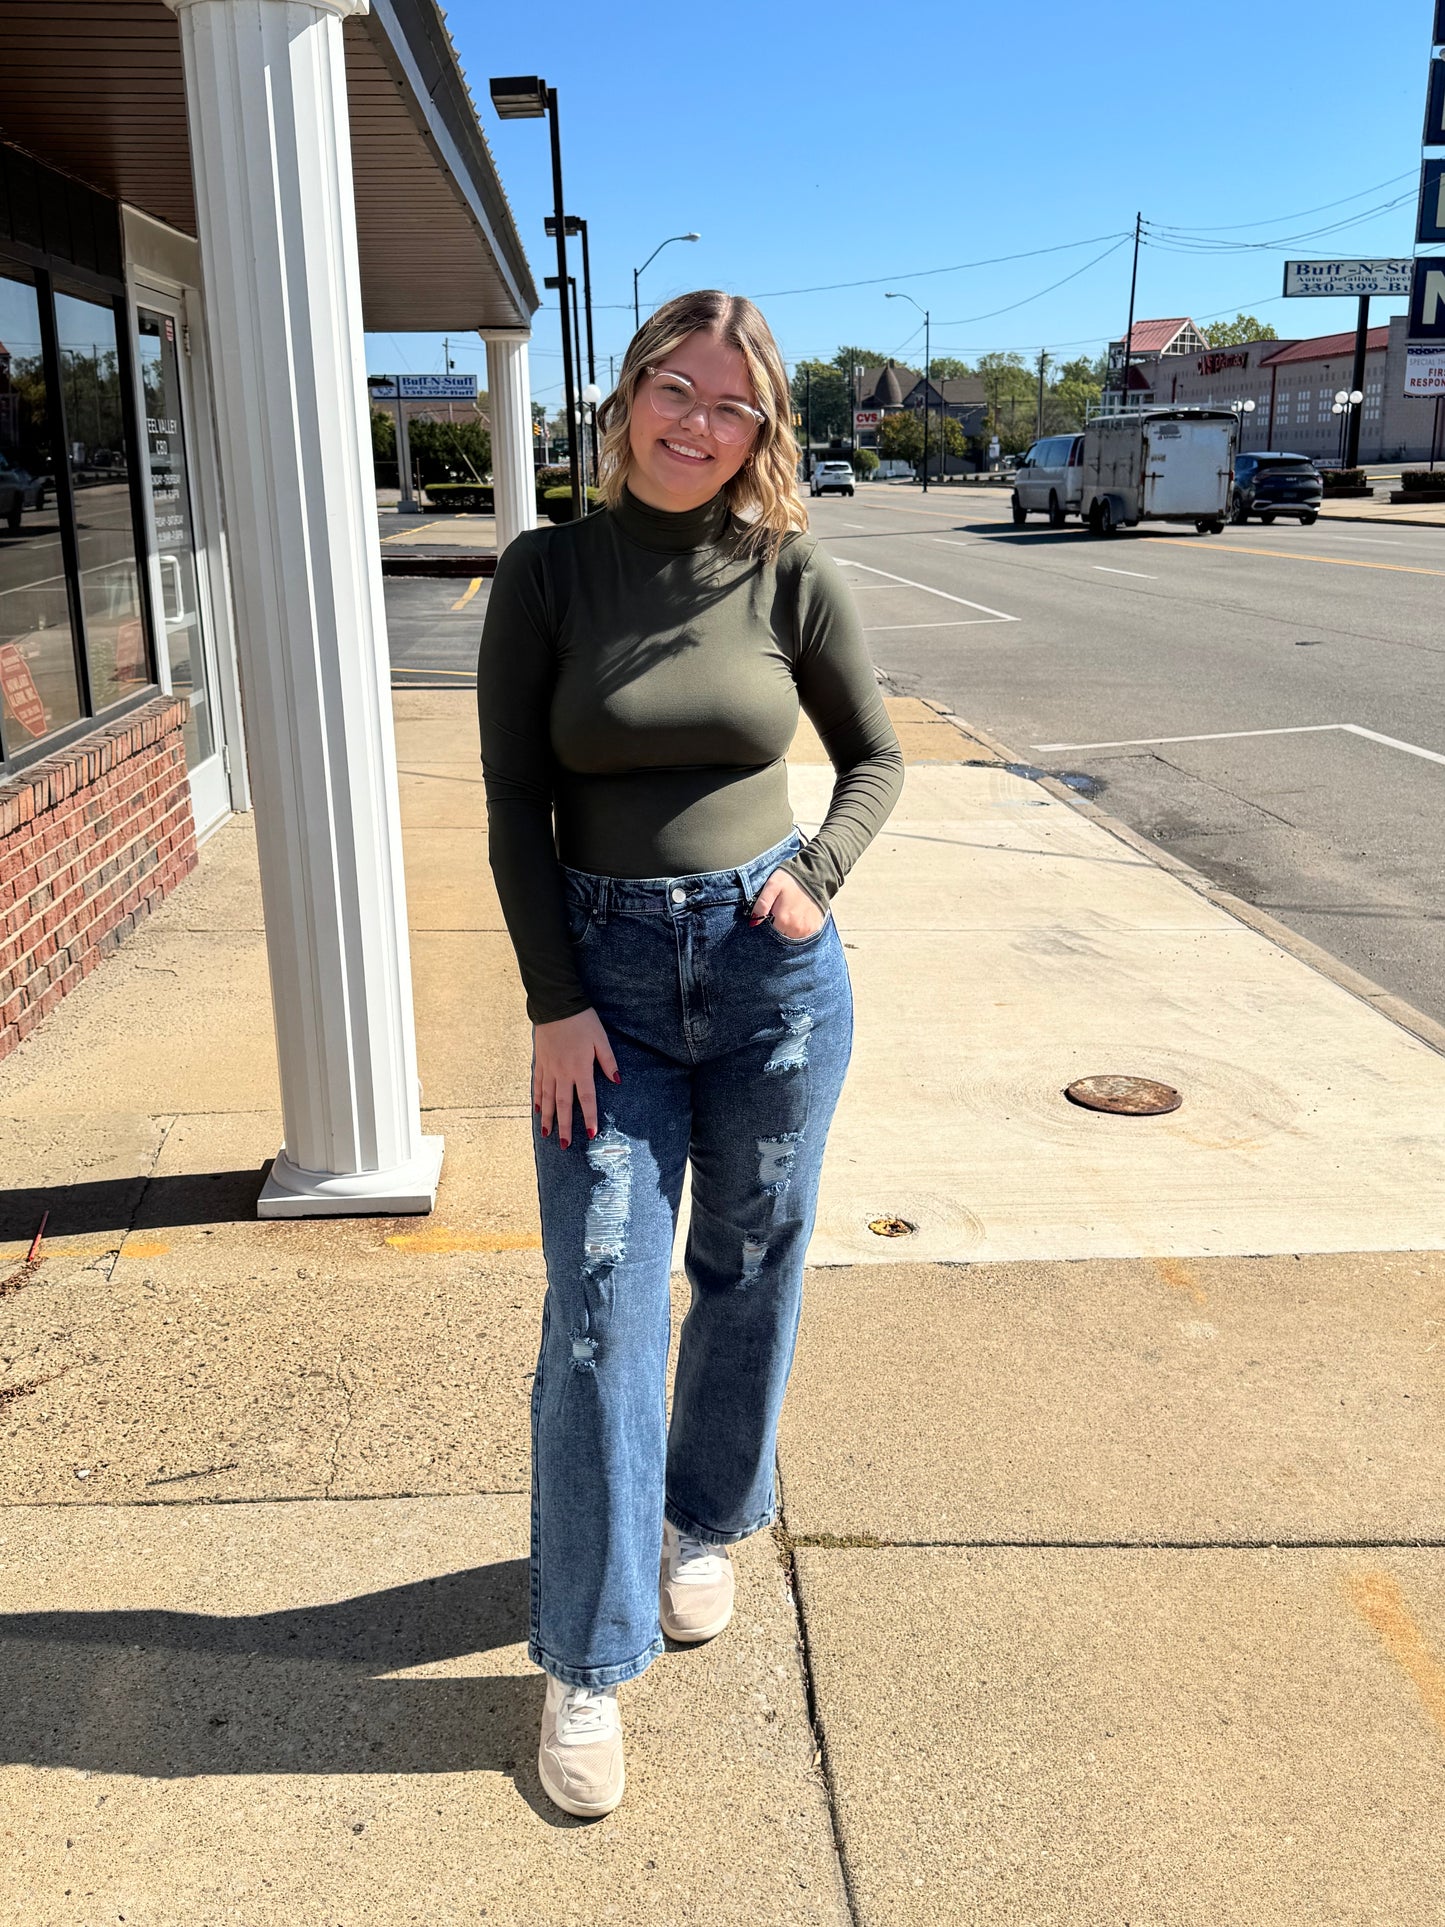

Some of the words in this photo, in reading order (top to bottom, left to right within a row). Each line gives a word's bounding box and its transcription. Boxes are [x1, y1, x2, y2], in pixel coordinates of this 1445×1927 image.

[1409, 358, 1435, 366] SPECIAL
[1428, 368, 1445, 377] FIR
[402, 377, 474, 386] Buff-N-Stuff
[856, 413, 878, 423] CVS
[158, 419, 177, 434] VALLEY
[156, 440, 168, 455] CBD
